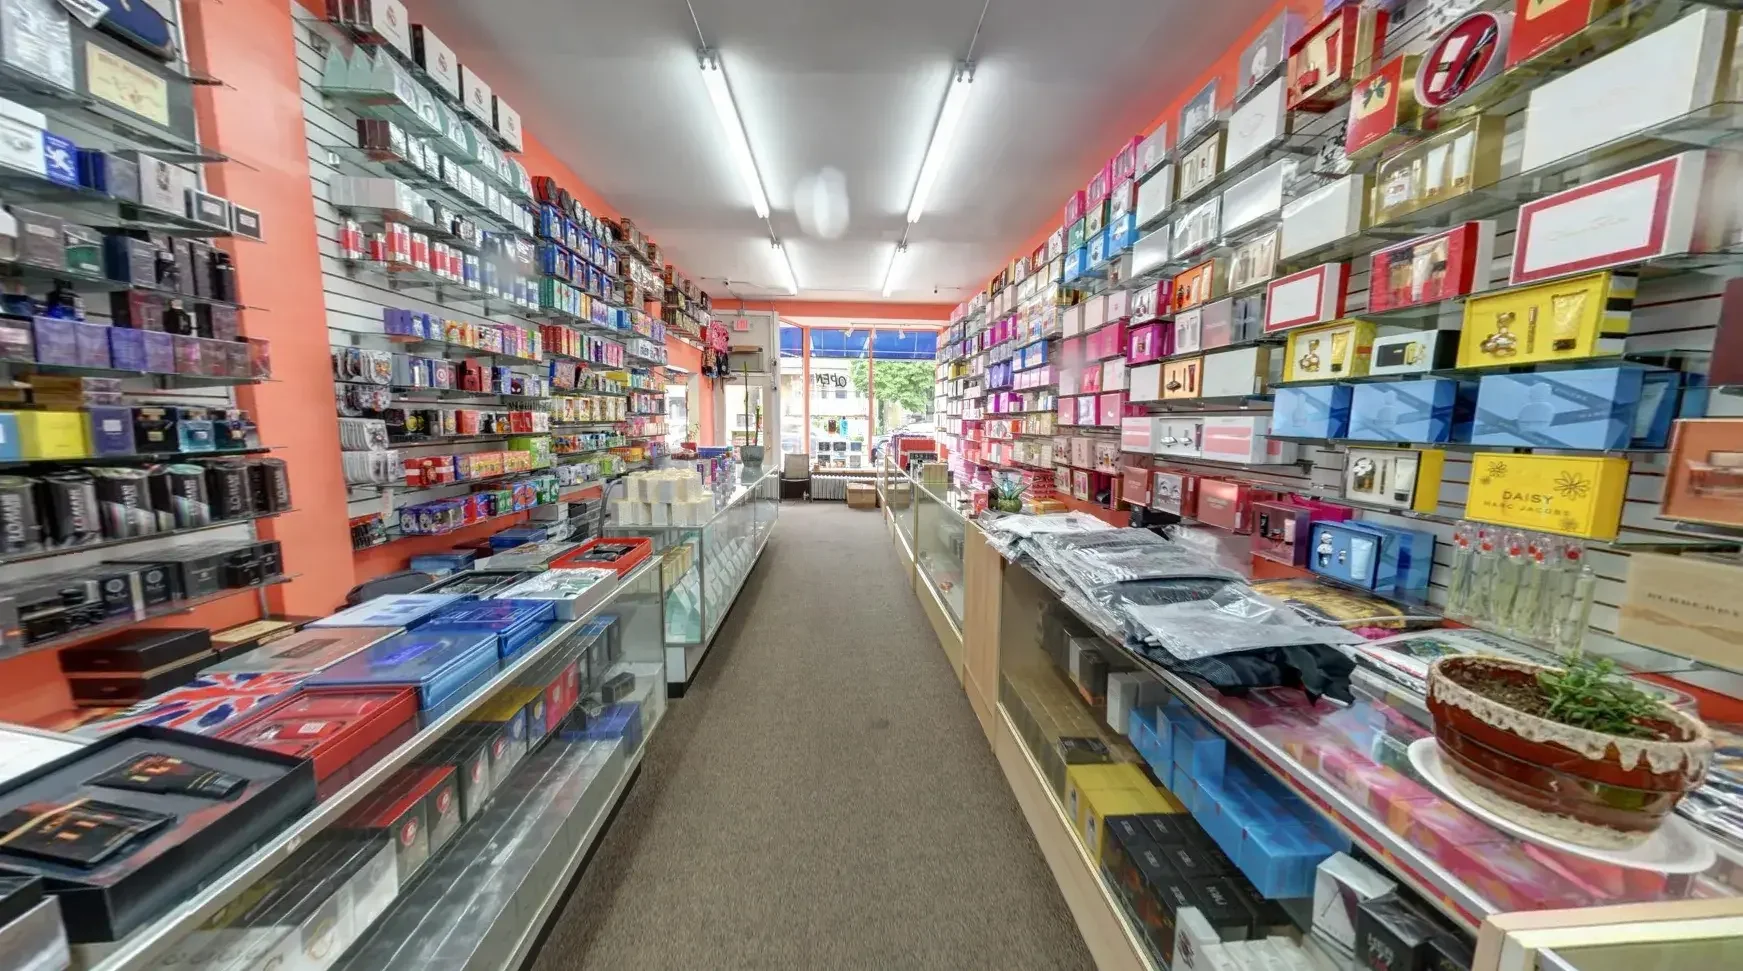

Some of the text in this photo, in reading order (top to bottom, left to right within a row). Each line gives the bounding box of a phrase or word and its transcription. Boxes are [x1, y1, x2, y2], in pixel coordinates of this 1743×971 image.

[1502, 490, 1555, 505] DAISY
[1484, 500, 1571, 517] MARC JACOBS
